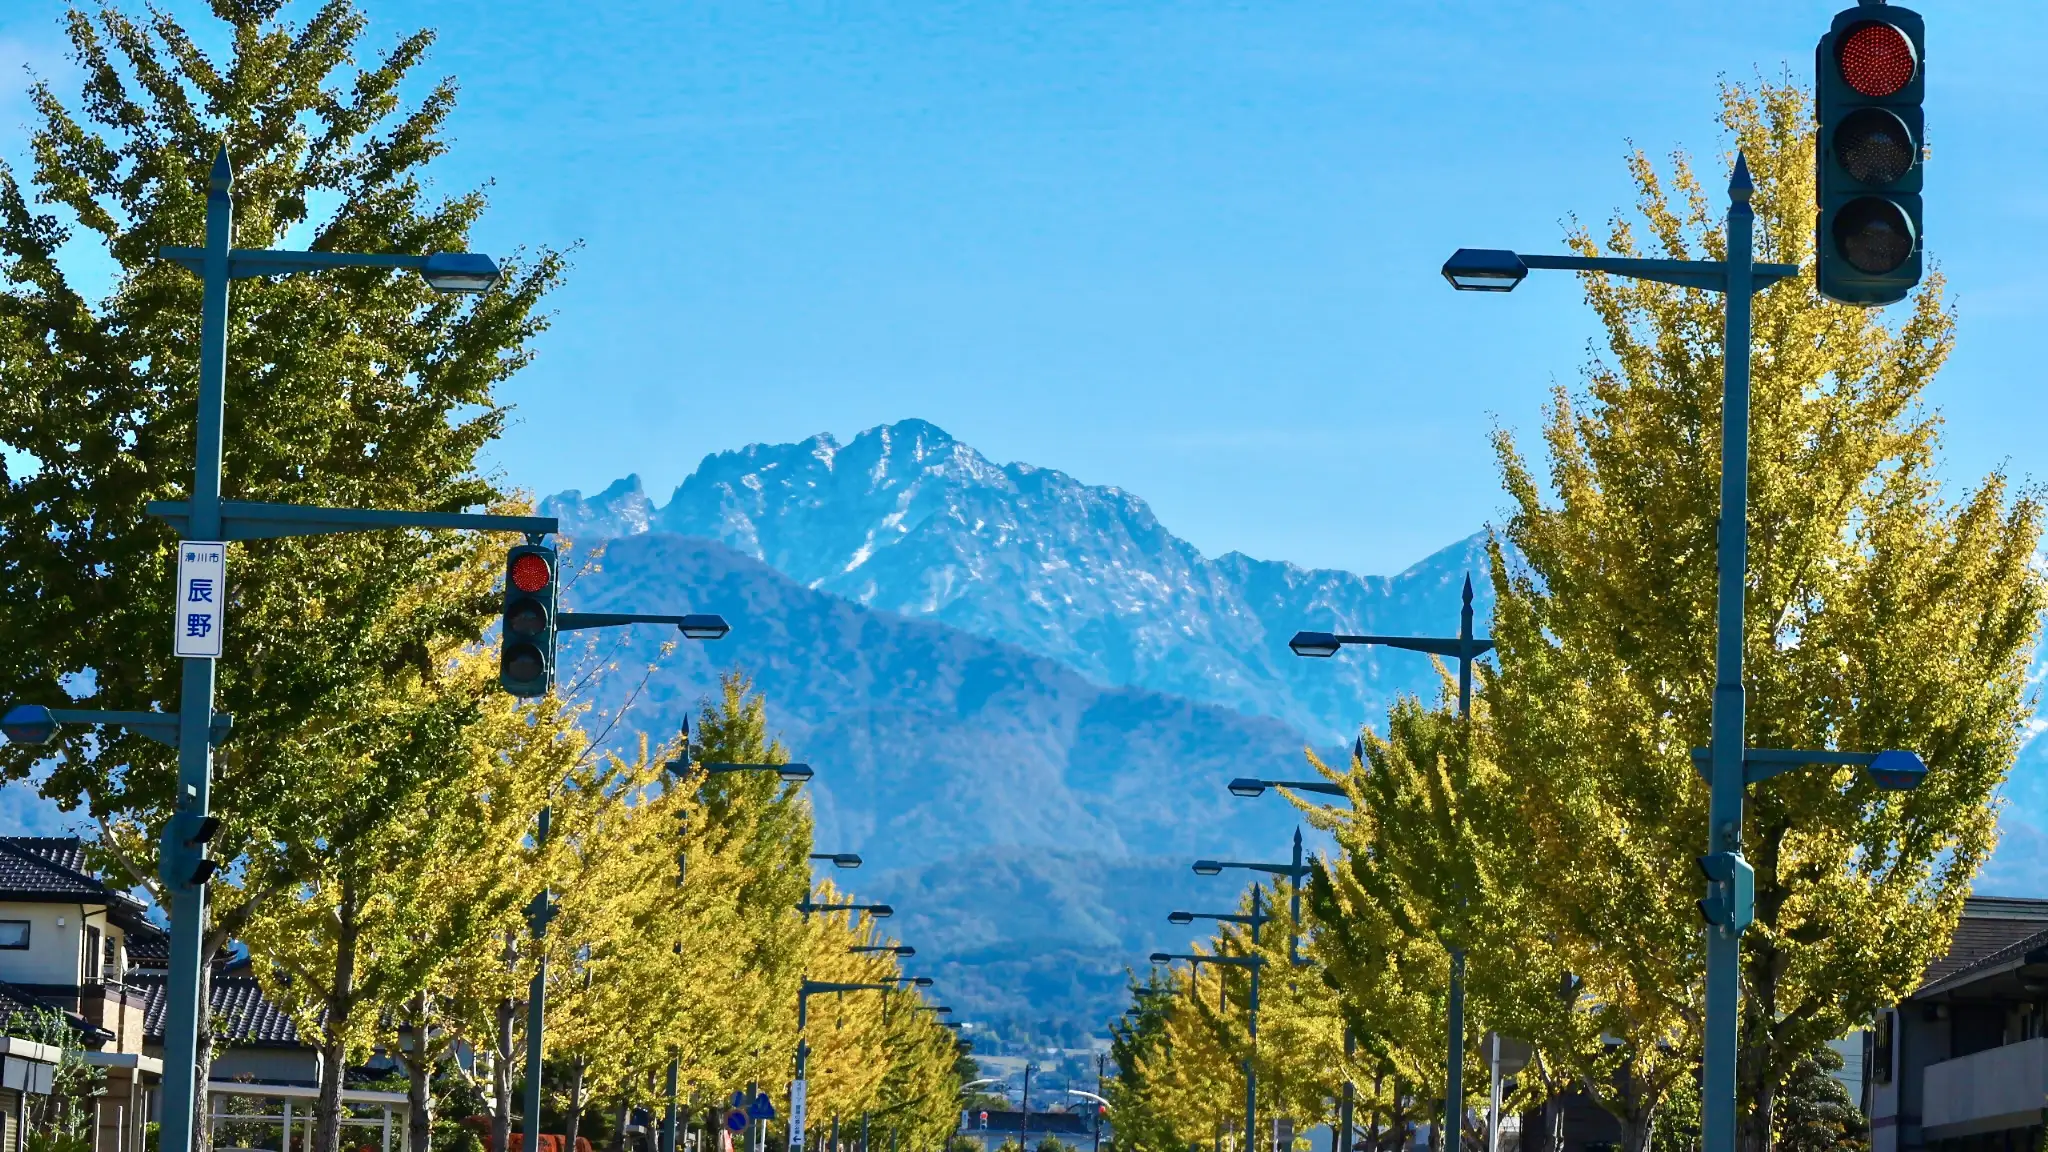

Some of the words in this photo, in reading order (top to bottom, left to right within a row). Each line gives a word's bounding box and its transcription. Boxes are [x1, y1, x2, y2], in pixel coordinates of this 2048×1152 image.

[185, 552, 219, 563] 滑川市
[186, 578, 213, 637] 辰野
